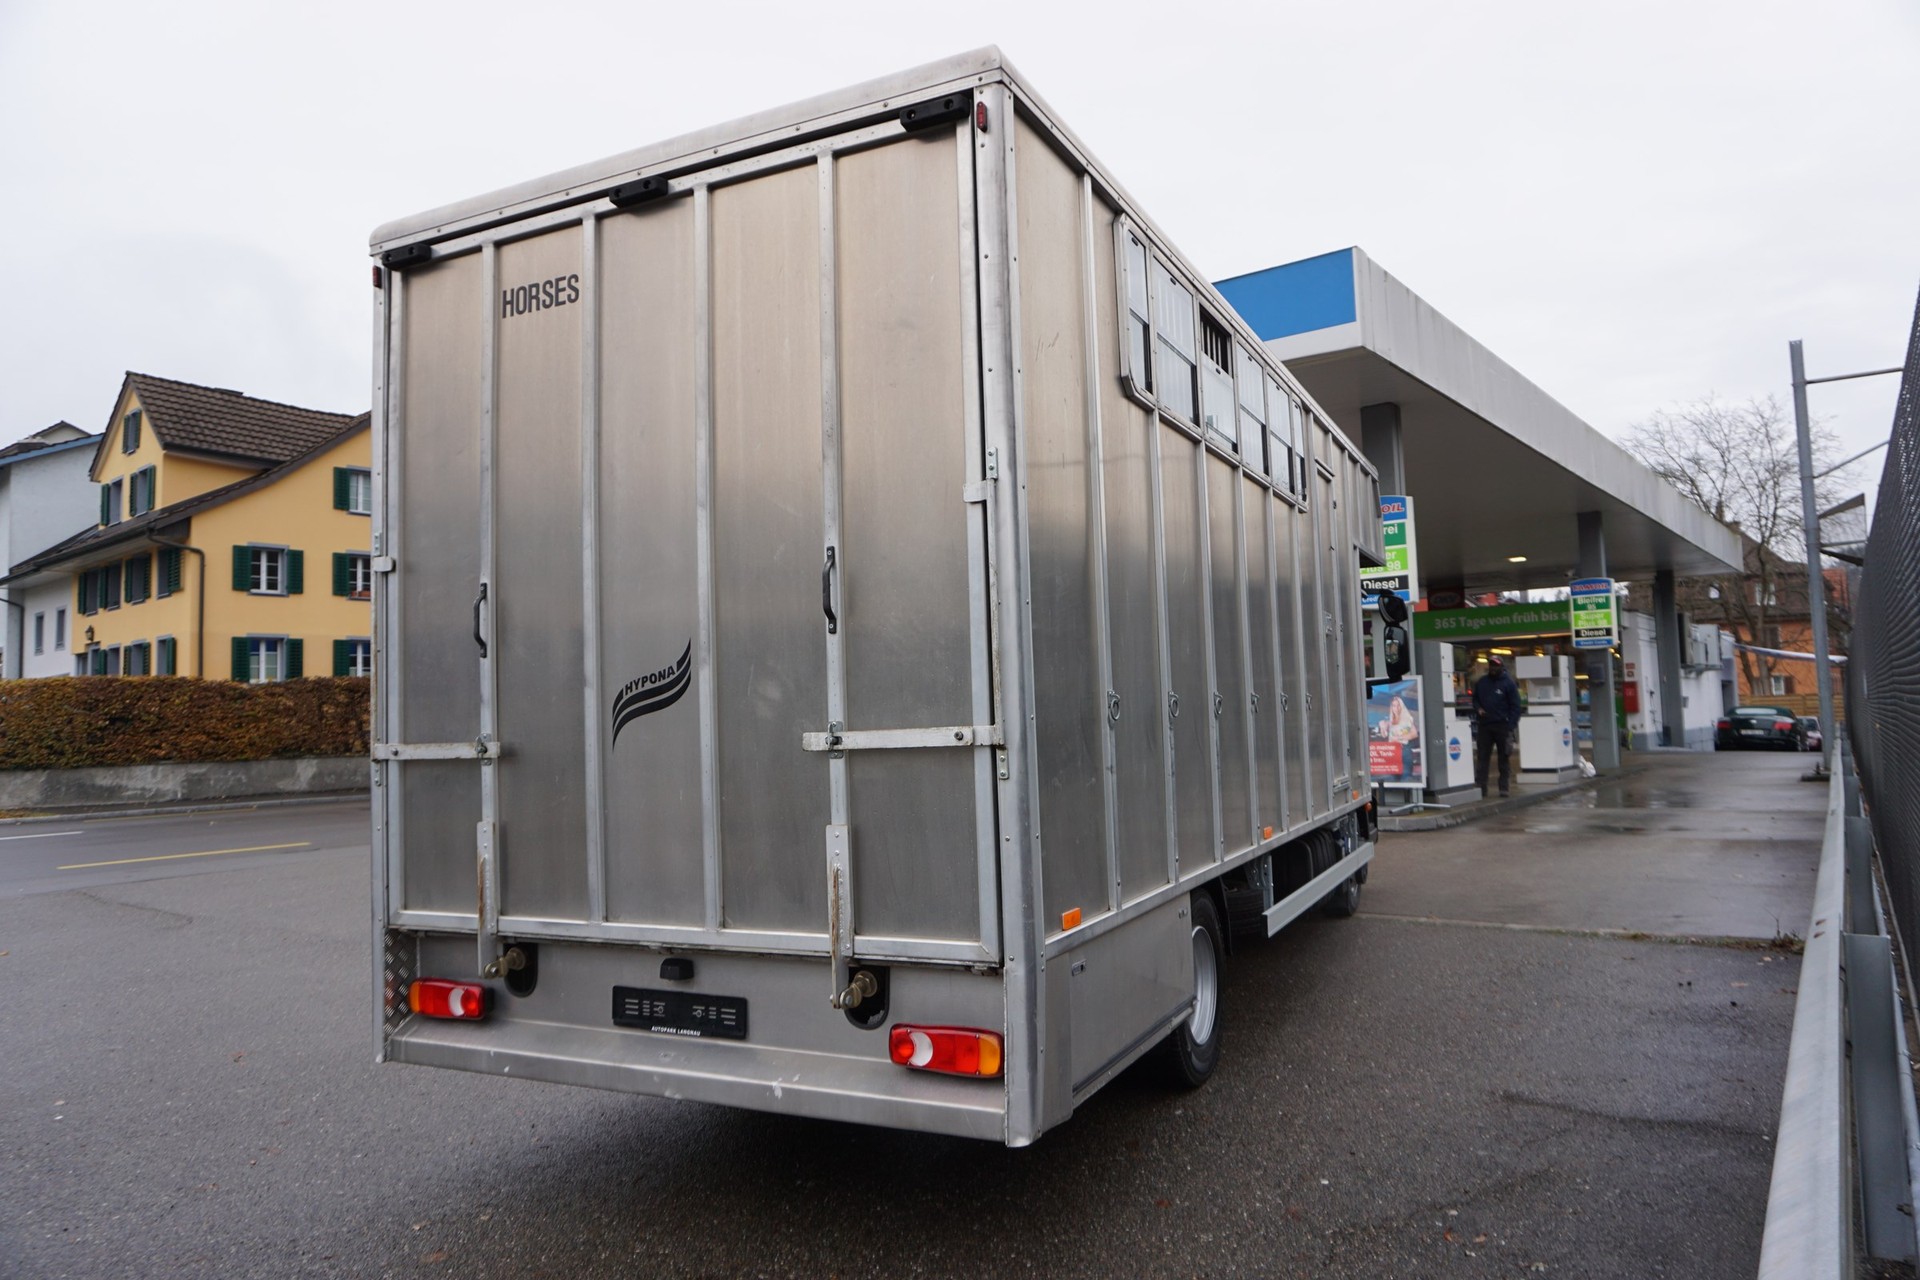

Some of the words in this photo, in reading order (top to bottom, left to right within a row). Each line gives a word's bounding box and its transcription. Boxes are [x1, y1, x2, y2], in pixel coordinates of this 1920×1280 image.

[502, 273, 580, 319] HORSES
[1380, 502, 1405, 514] OIL
[1386, 560, 1401, 571] 98
[1363, 578, 1399, 589] Diesel
[1434, 617, 1456, 630] 365
[1458, 615, 1487, 630] Tage
[1488, 614, 1511, 625] von
[1512, 611, 1539, 624] früh
[1541, 610, 1559, 622] bis
[1581, 628, 1607, 637] Diesel
[624, 665, 676, 696] HYPONA
[651, 1025, 677, 1035] AUTOPARK
[677, 1028, 701, 1037] LANGNAU
